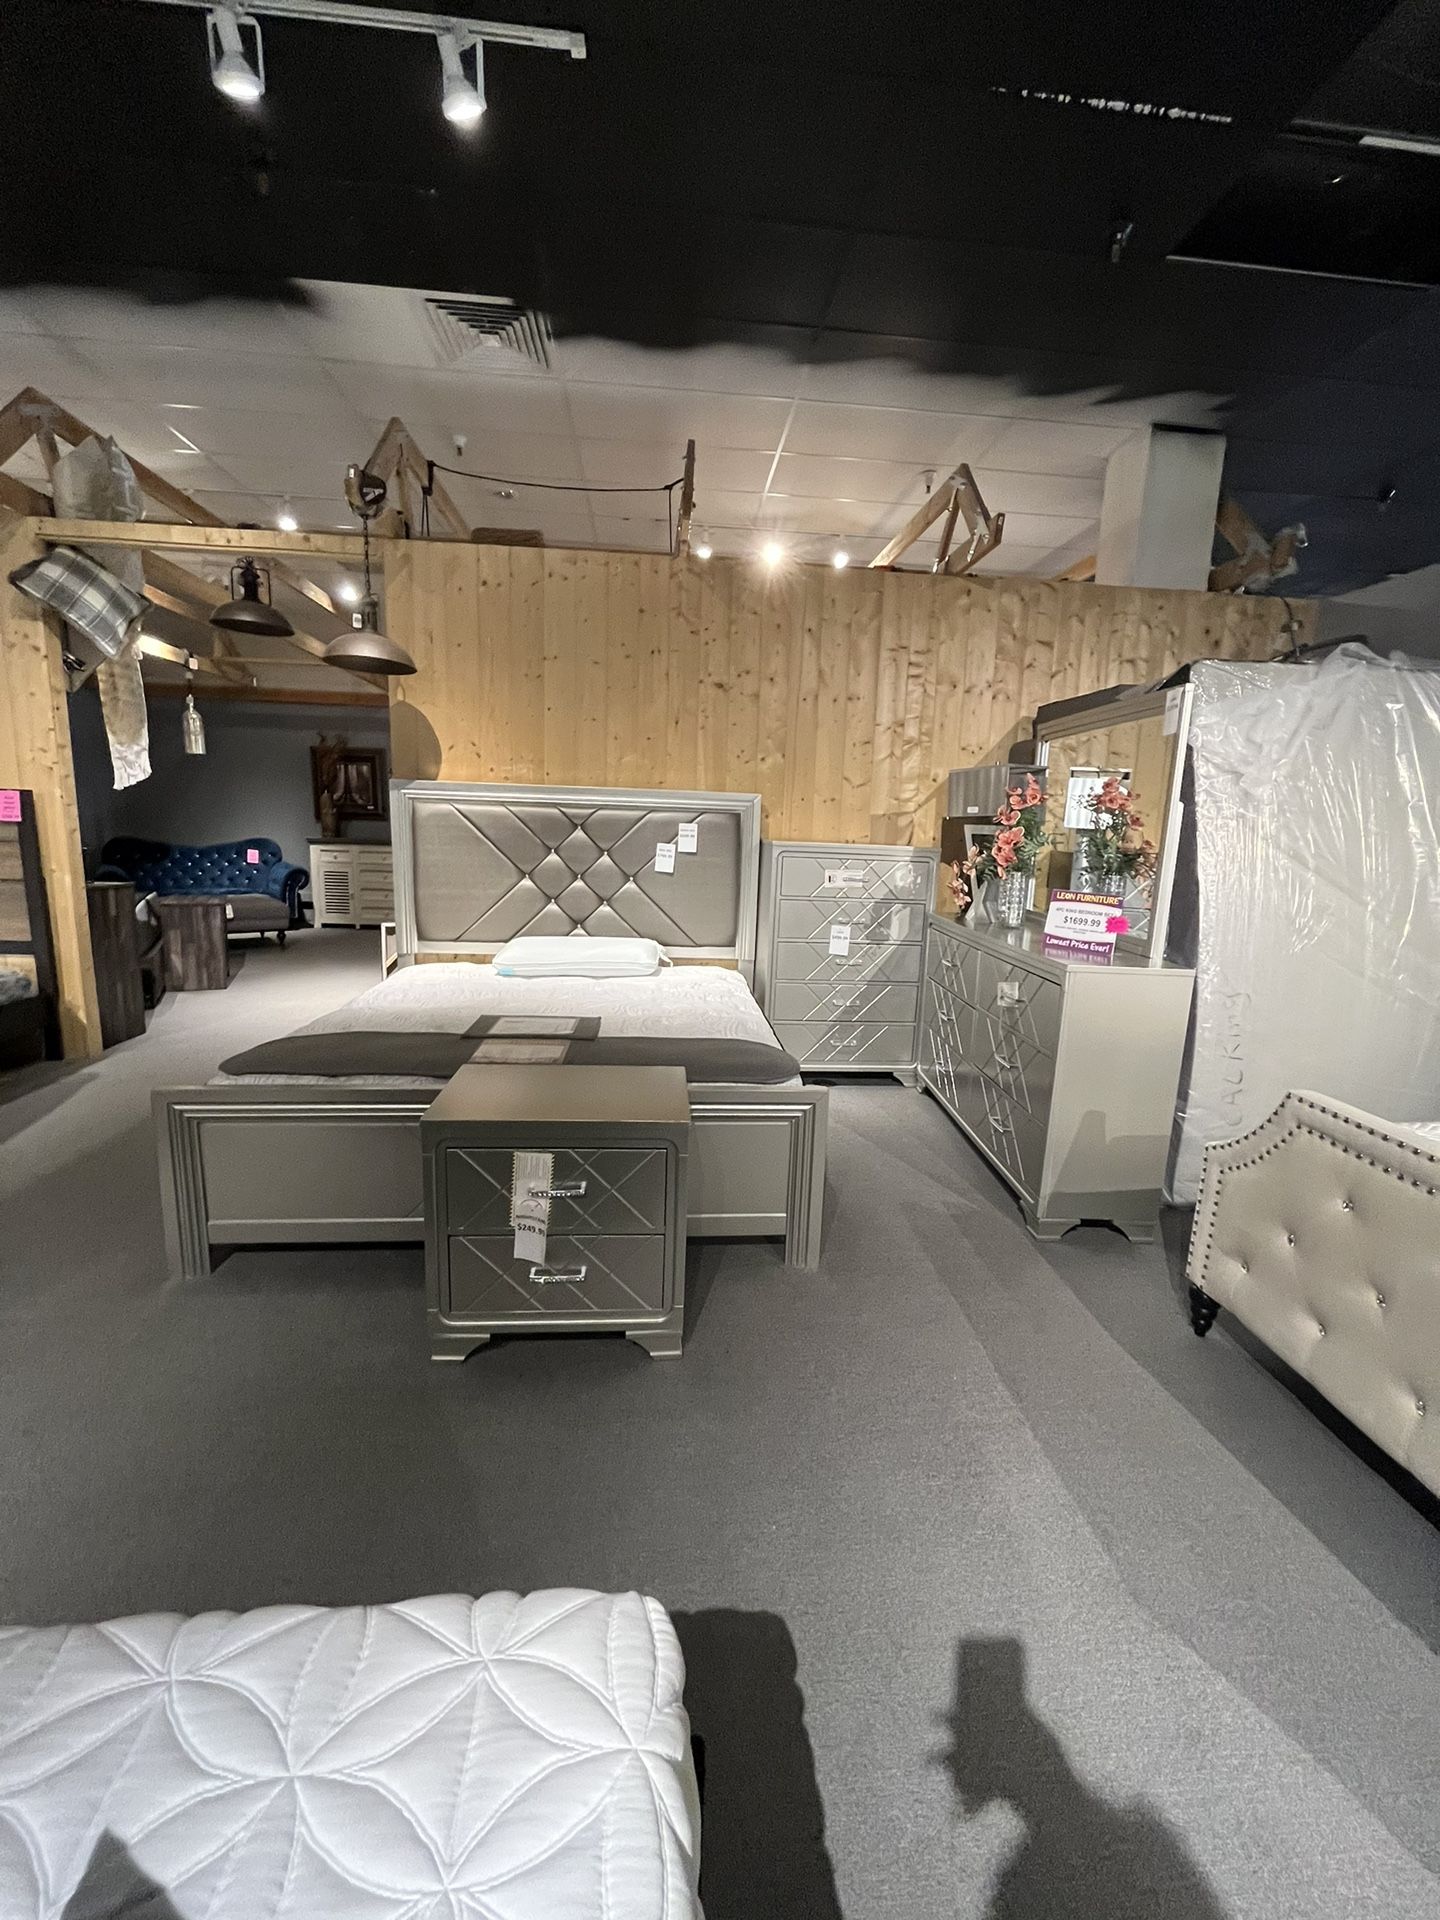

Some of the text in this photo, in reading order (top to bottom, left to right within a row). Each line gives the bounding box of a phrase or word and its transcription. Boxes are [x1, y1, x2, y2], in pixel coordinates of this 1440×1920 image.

[1057, 891, 1119, 905] LEON FURNITURE
[1063, 916, 1101, 927] $1699.99
[1046, 936, 1109, 953] Lowest Price Ever!
